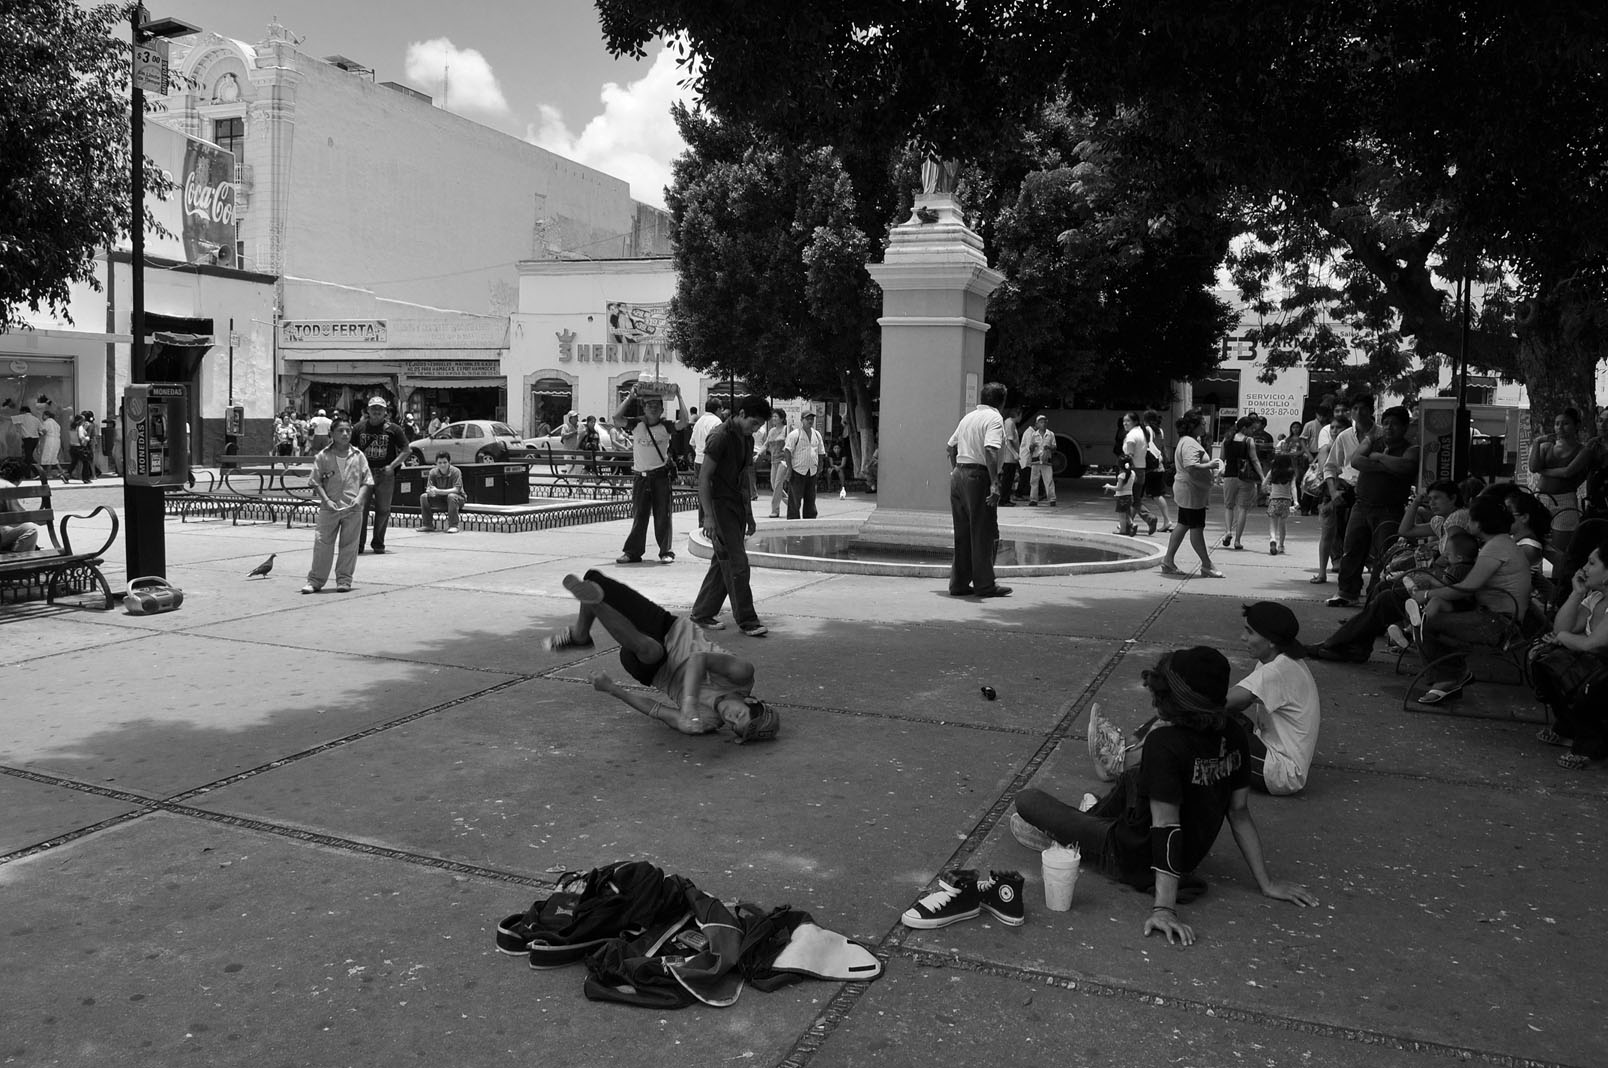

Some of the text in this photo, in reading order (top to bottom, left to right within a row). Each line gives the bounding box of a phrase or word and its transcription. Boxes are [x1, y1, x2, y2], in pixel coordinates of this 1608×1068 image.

[1246, 393, 1285, 401] SERVICIO
[1247, 400, 1290, 408] DOMICILIO
[138, 424, 146, 474] MONEDAS
